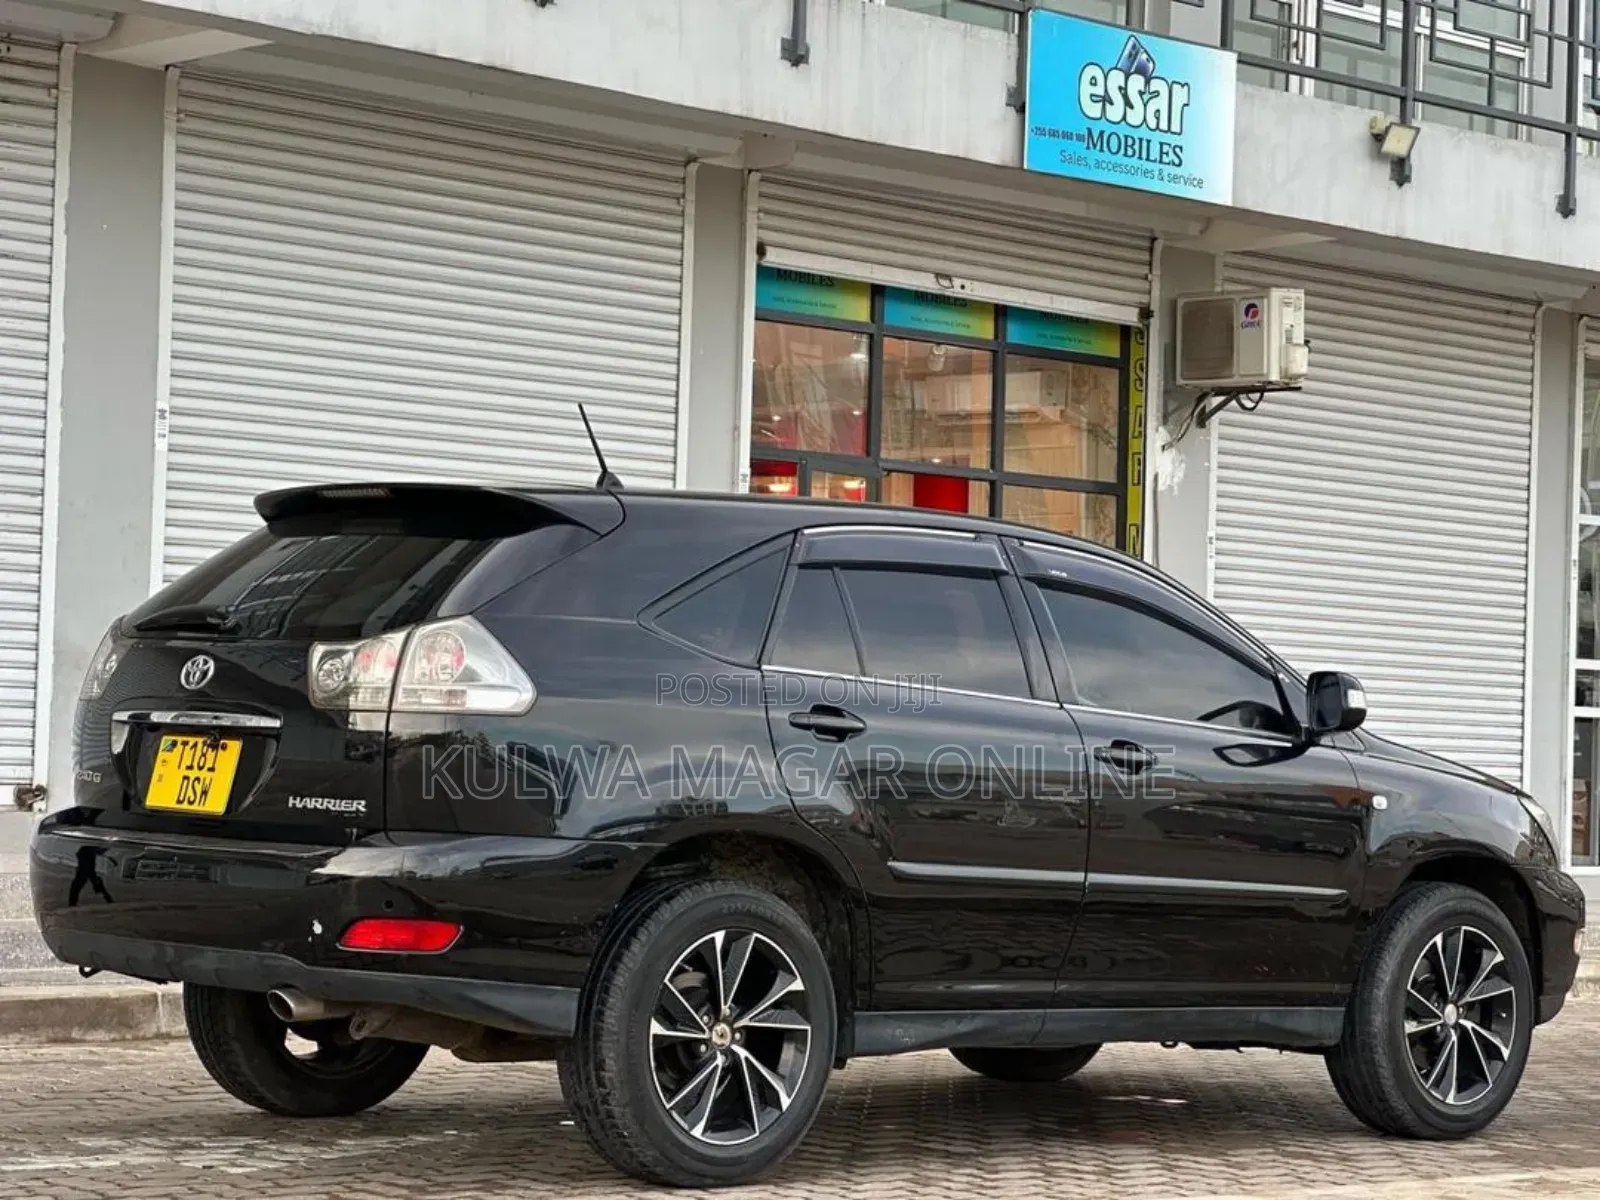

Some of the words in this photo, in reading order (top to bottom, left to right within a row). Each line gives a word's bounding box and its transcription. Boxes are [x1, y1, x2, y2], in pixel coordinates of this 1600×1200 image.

[1078, 61, 1191, 136] essar
[1085, 126, 1184, 168] MOBILES
[1059, 149, 1091, 170] Sales,
[1094, 157, 1155, 181] accessories
[1157, 168, 1165, 182] &
[1167, 171, 1204, 189] service
[177, 739, 220, 773] T181
[176, 775, 213, 806] DSW
[287, 795, 367, 812] HARRIER
